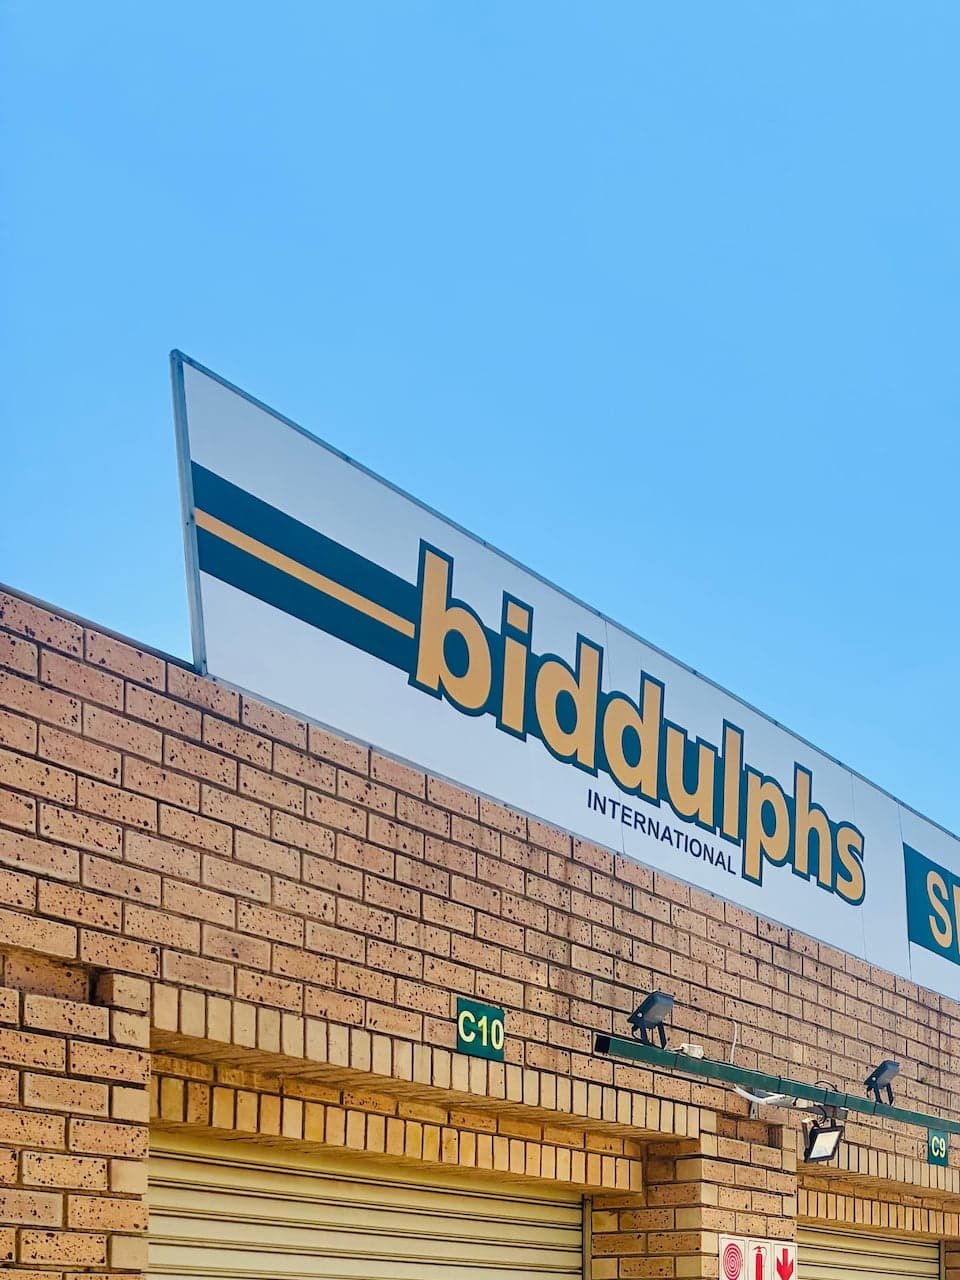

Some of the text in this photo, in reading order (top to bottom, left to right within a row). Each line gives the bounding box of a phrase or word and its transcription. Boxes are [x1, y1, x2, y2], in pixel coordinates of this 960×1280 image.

[408, 538, 866, 907] biddulphs
[587, 788, 737, 875] INTERNATIONAL
[458, 1010, 504, 1050] C10
[931, 1135, 946, 1158] C9
